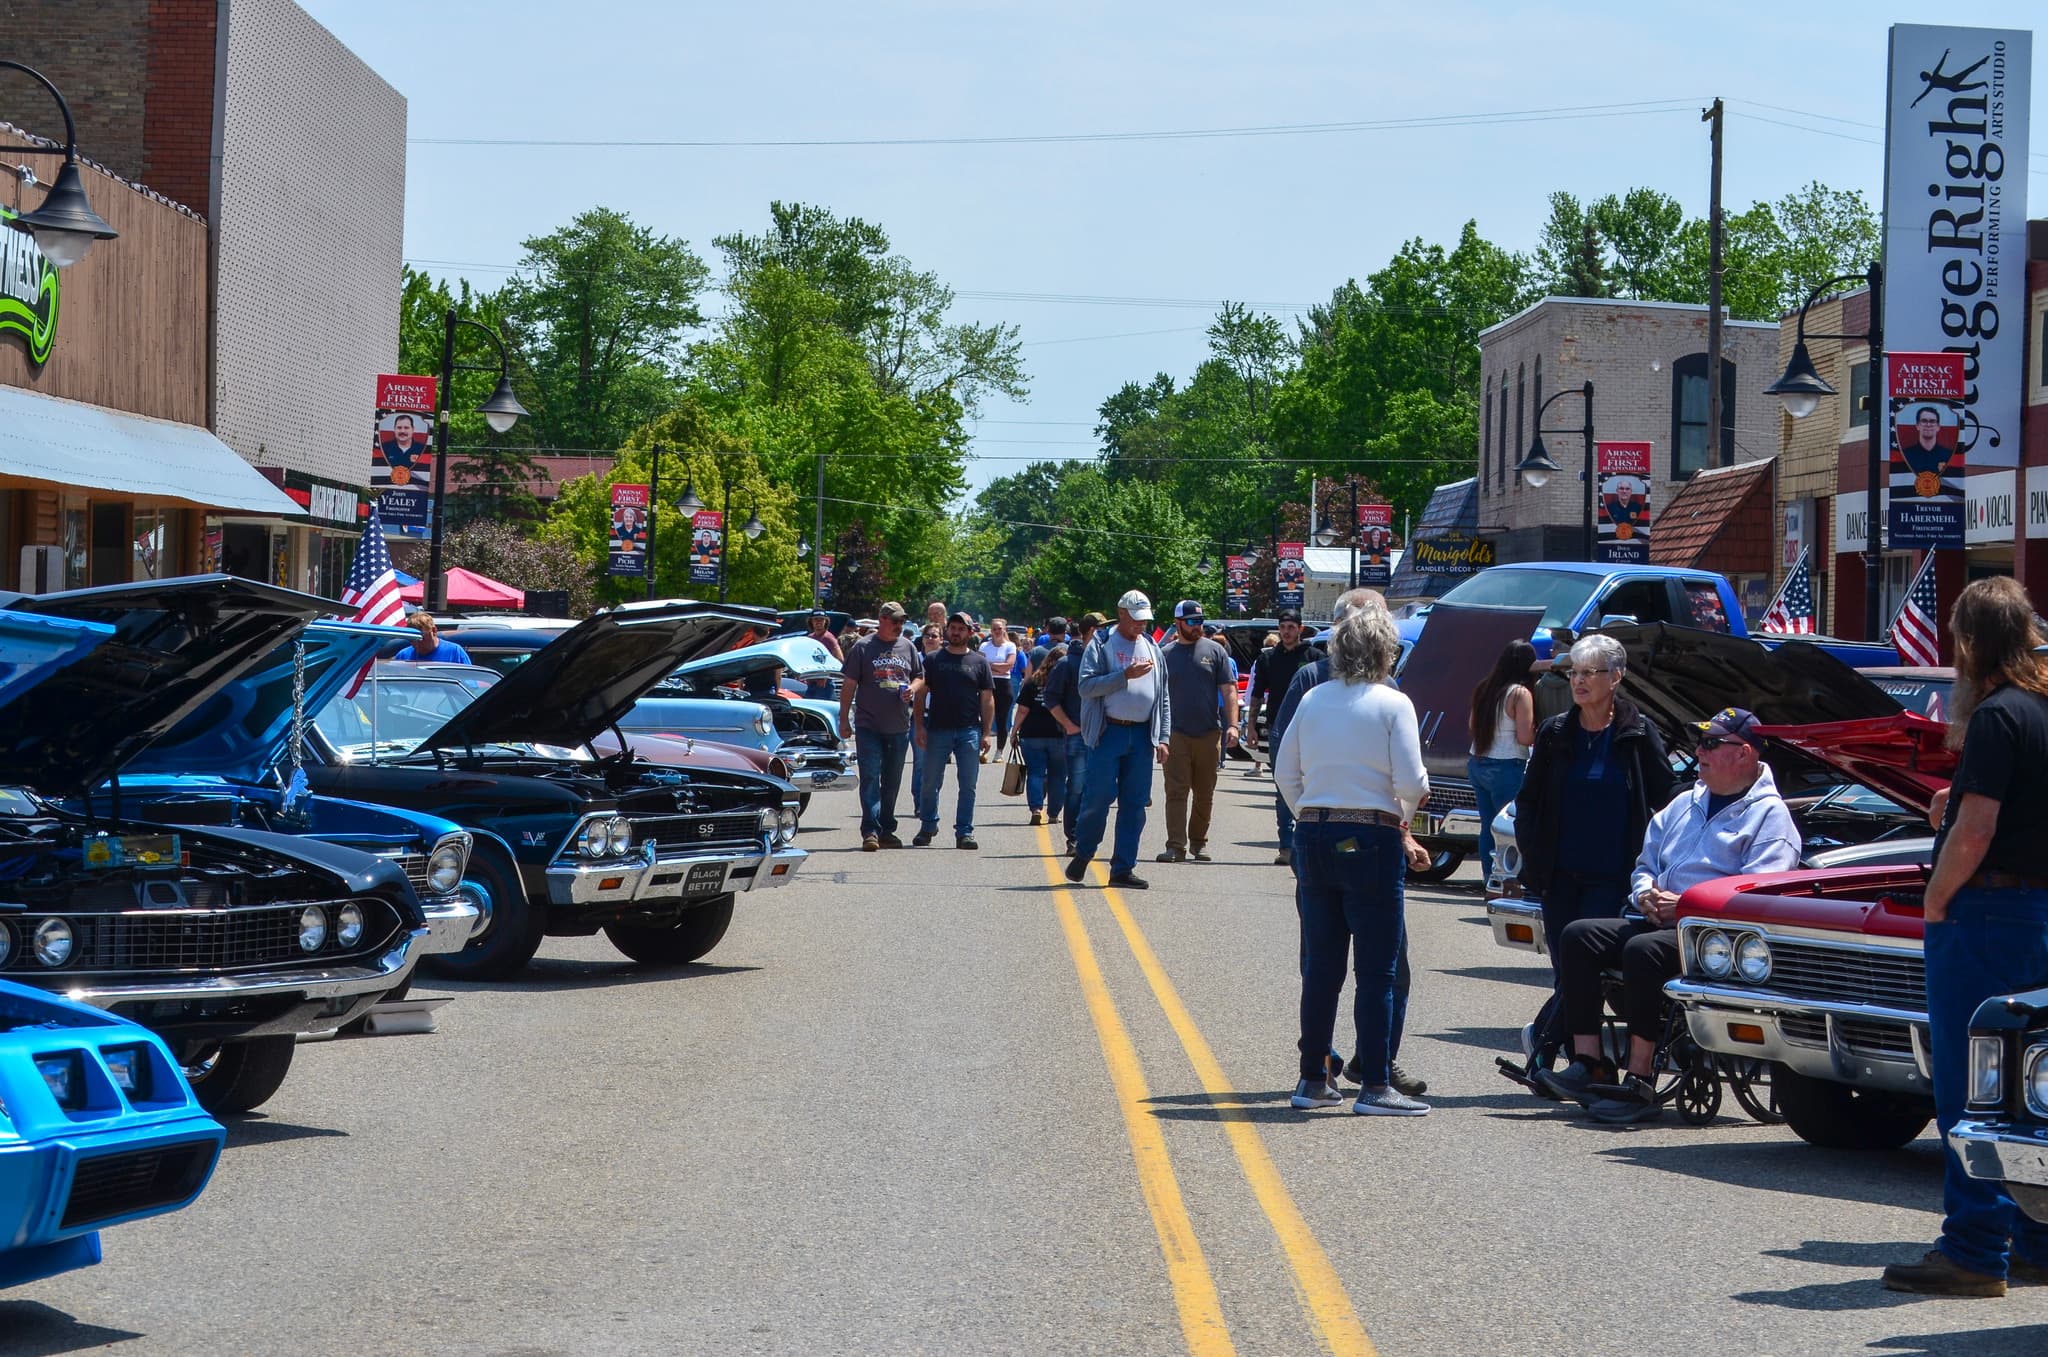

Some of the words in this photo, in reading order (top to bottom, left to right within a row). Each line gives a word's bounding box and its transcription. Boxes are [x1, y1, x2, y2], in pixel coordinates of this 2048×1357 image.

[1993, 40, 2006, 99] STUDIO
[1991, 101, 2004, 138] ARTS
[1986, 186, 2001, 297] PERFORMING
[1899, 363, 1953, 374] ARENAC
[384, 383, 427, 392] ARENAC
[1903, 379, 1948, 388] FIRST
[387, 394, 423, 404] FIRST
[381, 401, 430, 409] RESPONDERS
[1604, 449, 1642, 457] ARENAC
[1607, 459, 1640, 467] FIRST
[381, 494, 417, 507] YEALEY
[1915, 504, 1941, 512] TREVOR
[1846, 511, 1867, 540] DANCE
[1986, 494, 2013, 528] VOCAL
[1900, 512, 1957, 523] HABERMEHL
[1416, 536, 1494, 567] Marigolds
[1608, 549, 1640, 559] IRLAND
[699, 824, 714, 834] SS
[692, 870, 720, 879] BLACK
[688, 881, 720, 891] BETTY
